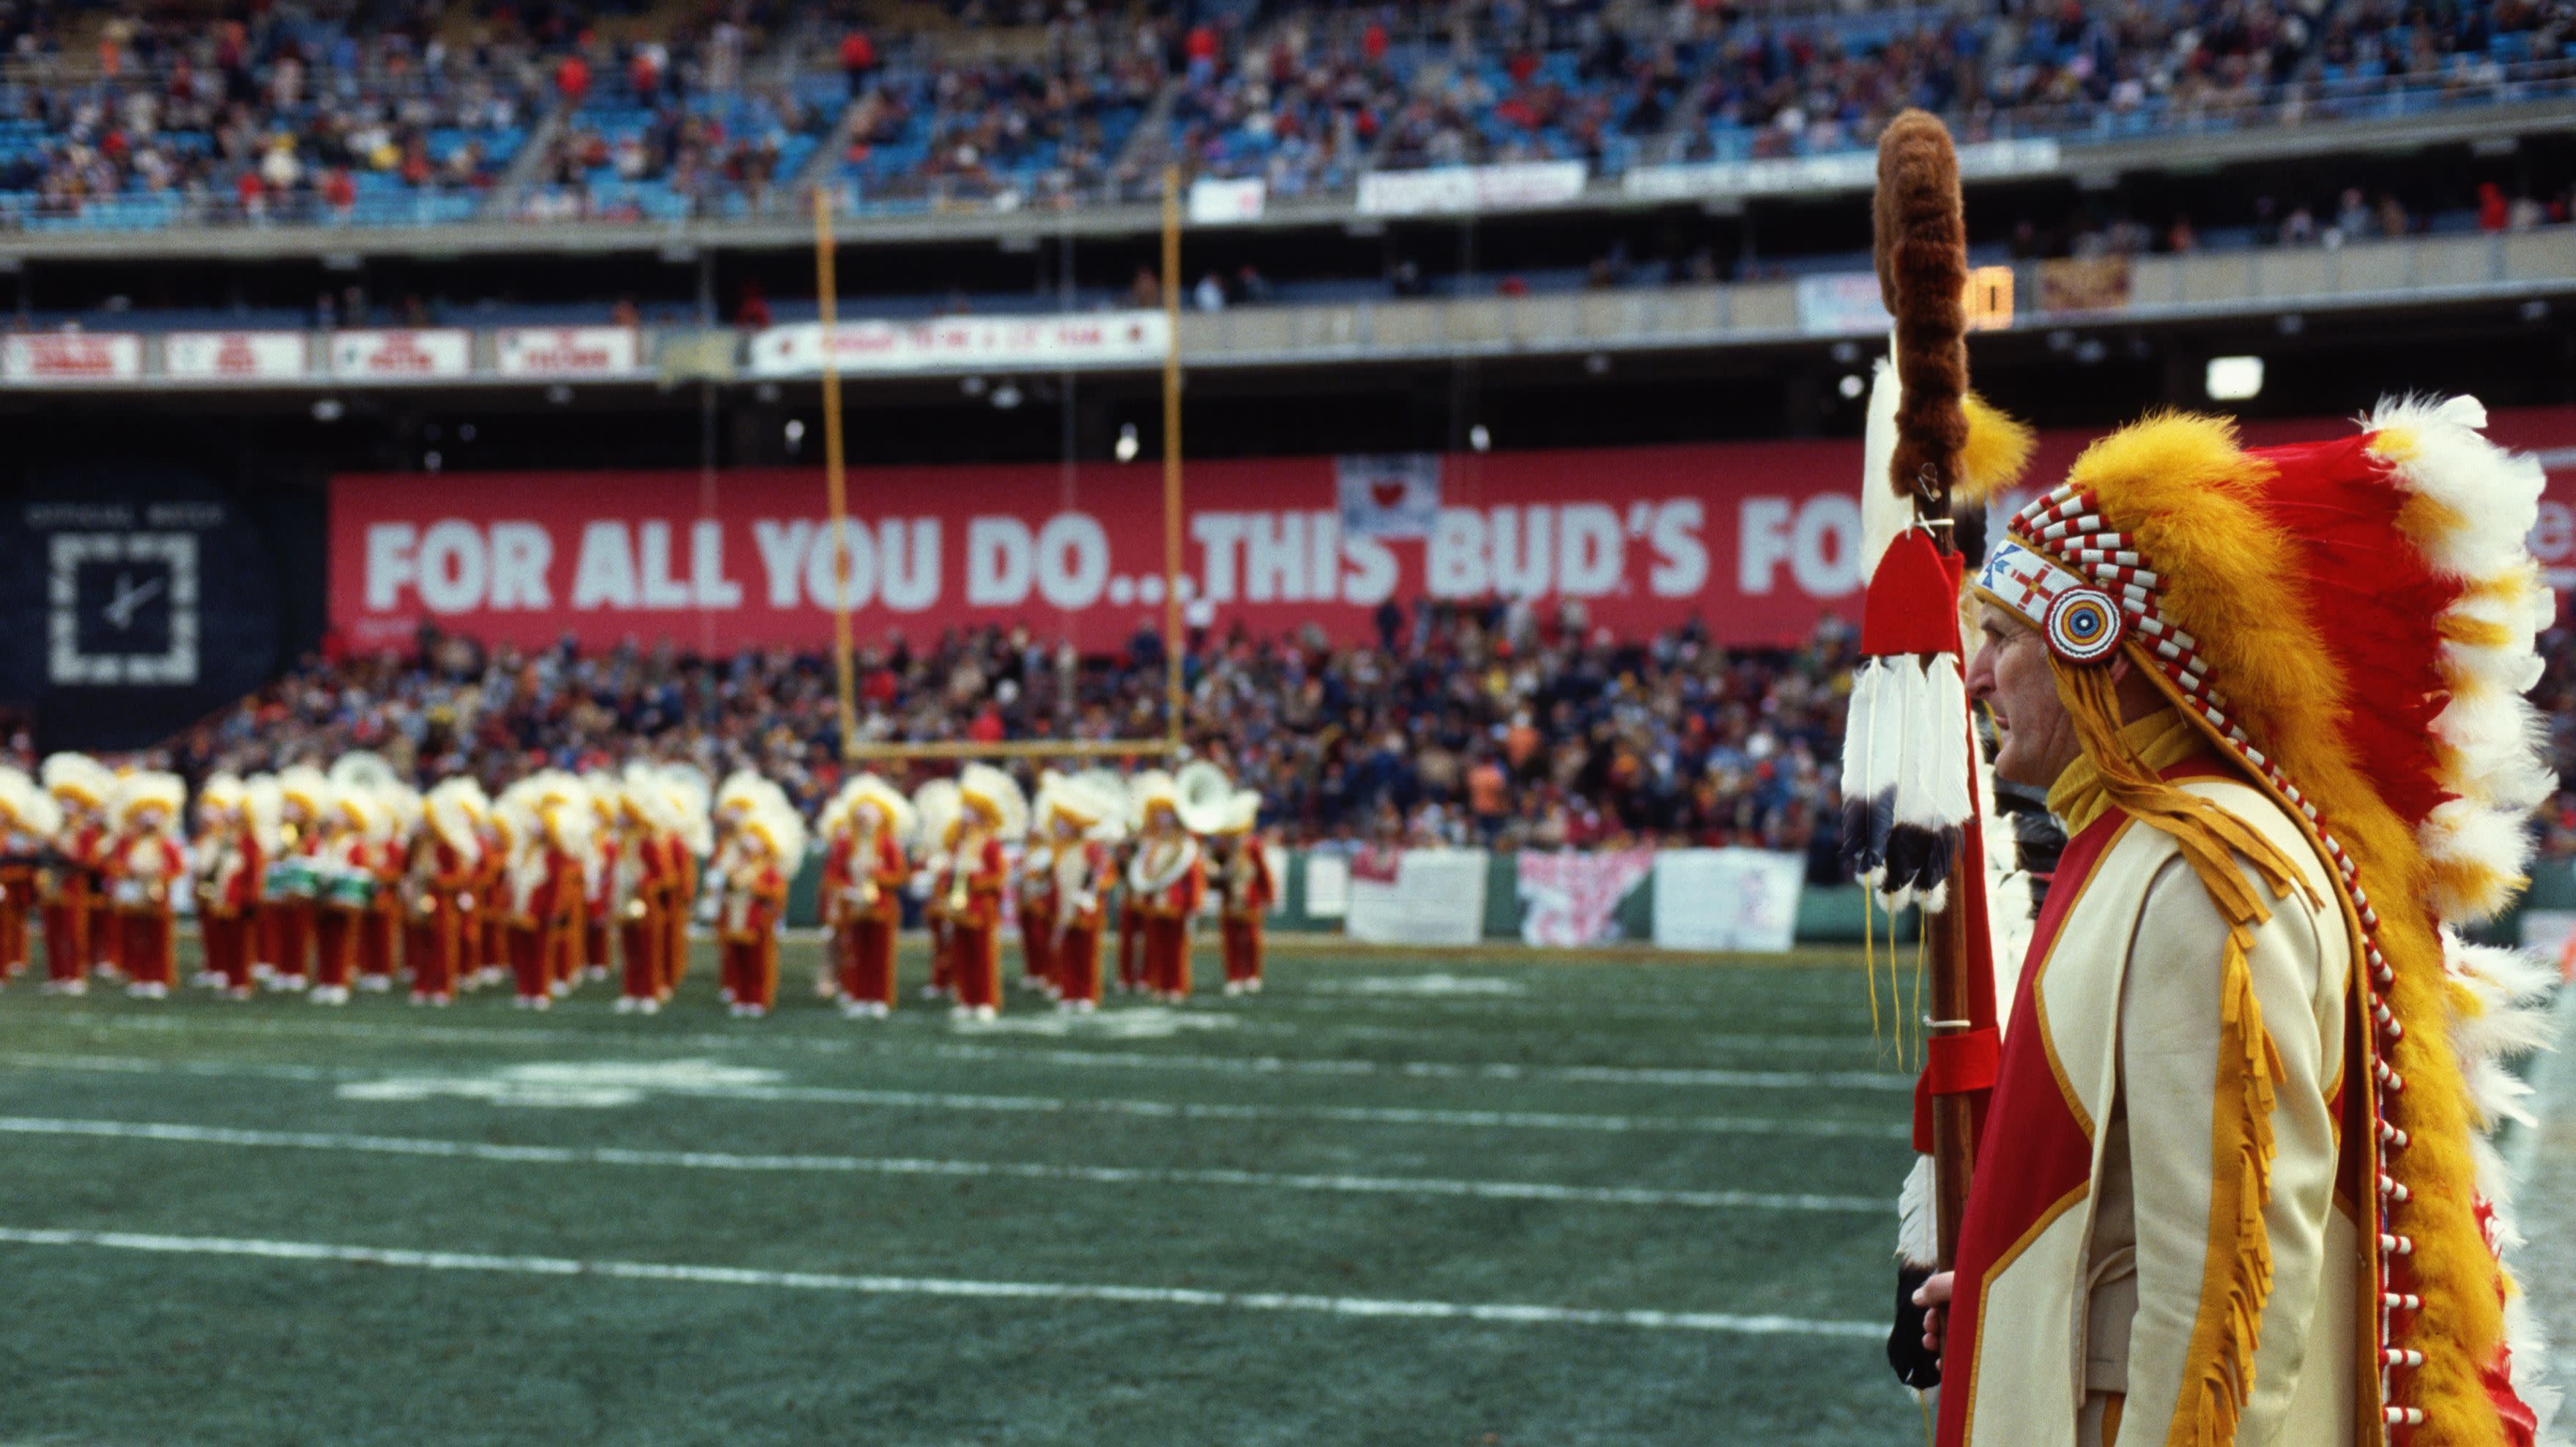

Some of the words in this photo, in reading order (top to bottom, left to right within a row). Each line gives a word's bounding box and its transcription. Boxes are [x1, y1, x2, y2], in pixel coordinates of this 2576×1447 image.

[368, 519, 554, 613] FOR
[571, 519, 743, 609] ALL
[751, 515, 943, 612] YOU
[1425, 496, 1709, 599] BUD'S
[1739, 493, 1863, 599] FO
